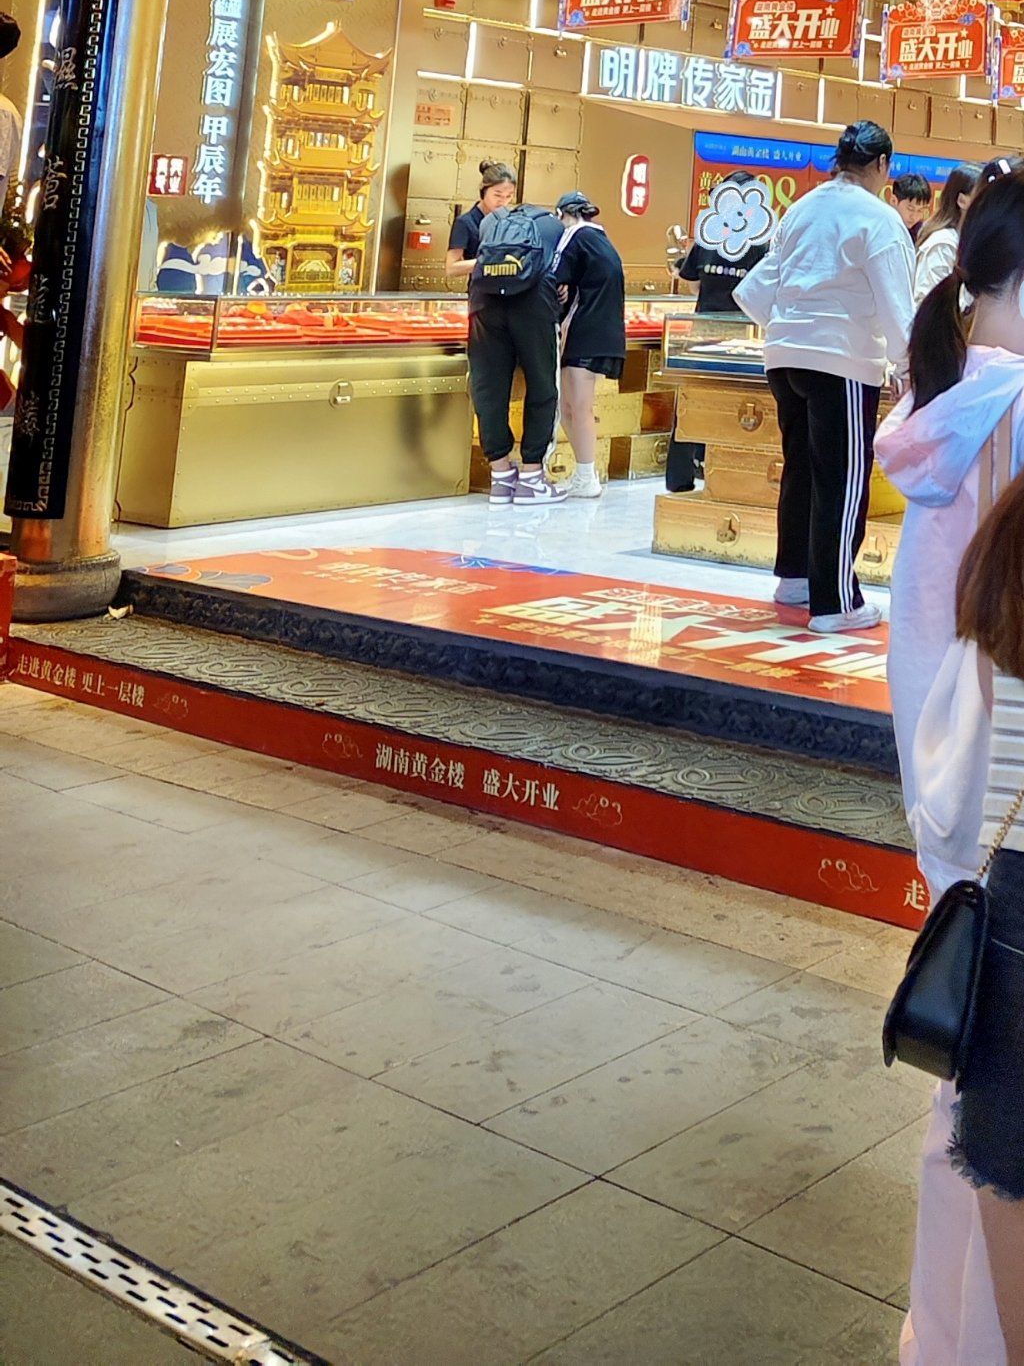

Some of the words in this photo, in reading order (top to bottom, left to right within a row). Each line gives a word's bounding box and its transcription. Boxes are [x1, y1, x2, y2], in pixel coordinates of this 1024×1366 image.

[747, 8, 840, 40] 盛大开业
[899, 32, 974, 63] 盛大开业
[600, 46, 775, 117] 明牌传家金
[483, 263, 518, 277] PUMA
[16, 653, 77, 689] 走进黄金楼
[82, 671, 145, 708] 更上一层楼
[375, 742, 465, 790] 湖南黄金楼
[482, 767, 561, 811] 盛大开业
